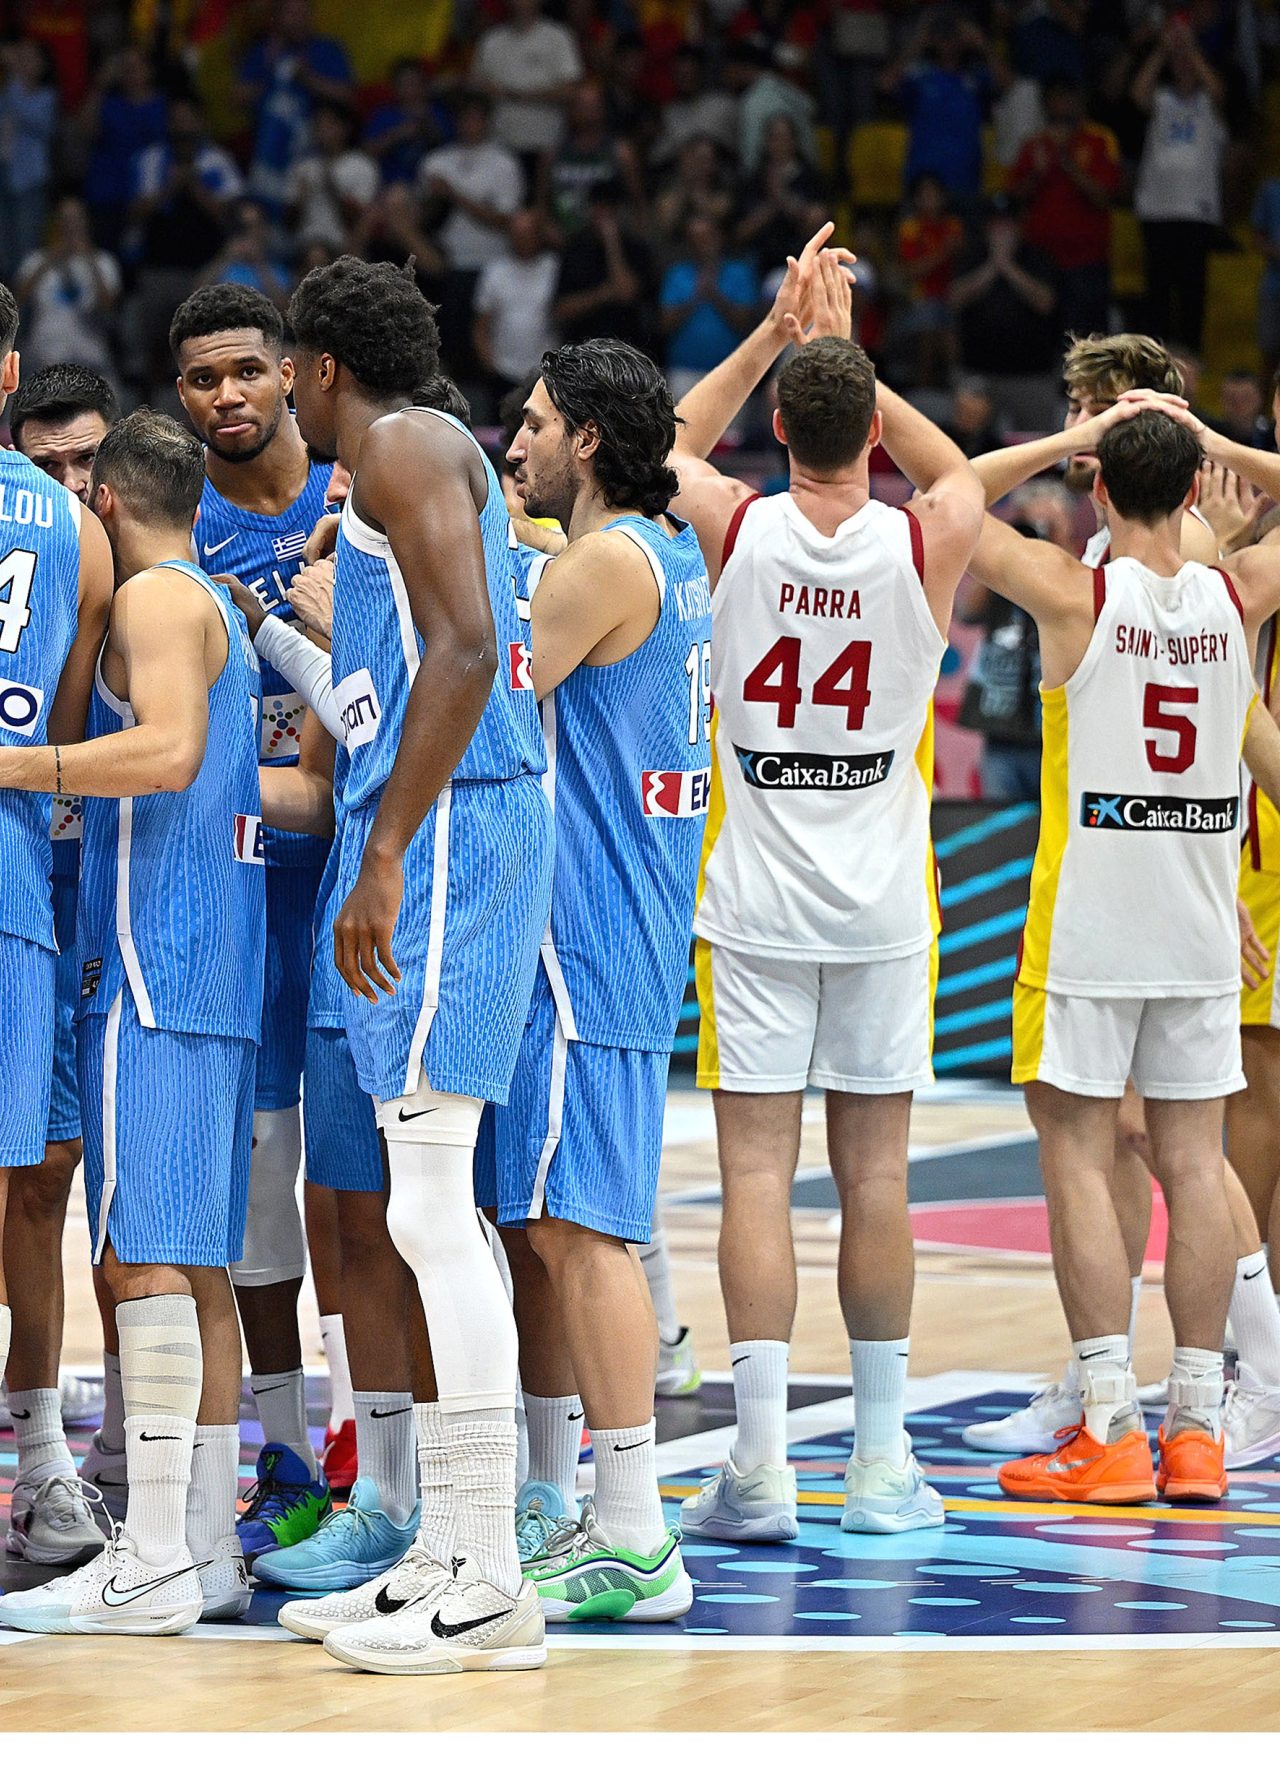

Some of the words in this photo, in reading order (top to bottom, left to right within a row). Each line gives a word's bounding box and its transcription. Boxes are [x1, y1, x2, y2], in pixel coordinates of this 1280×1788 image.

[779, 583, 862, 620] PARRA
[1116, 624, 1228, 665] SAINT-SUPÉRY
[742, 635, 873, 731] 44
[1142, 682, 1199, 774] 5
[755, 756, 888, 787] CaixaBank
[1122, 799, 1234, 830] CaixaBank
